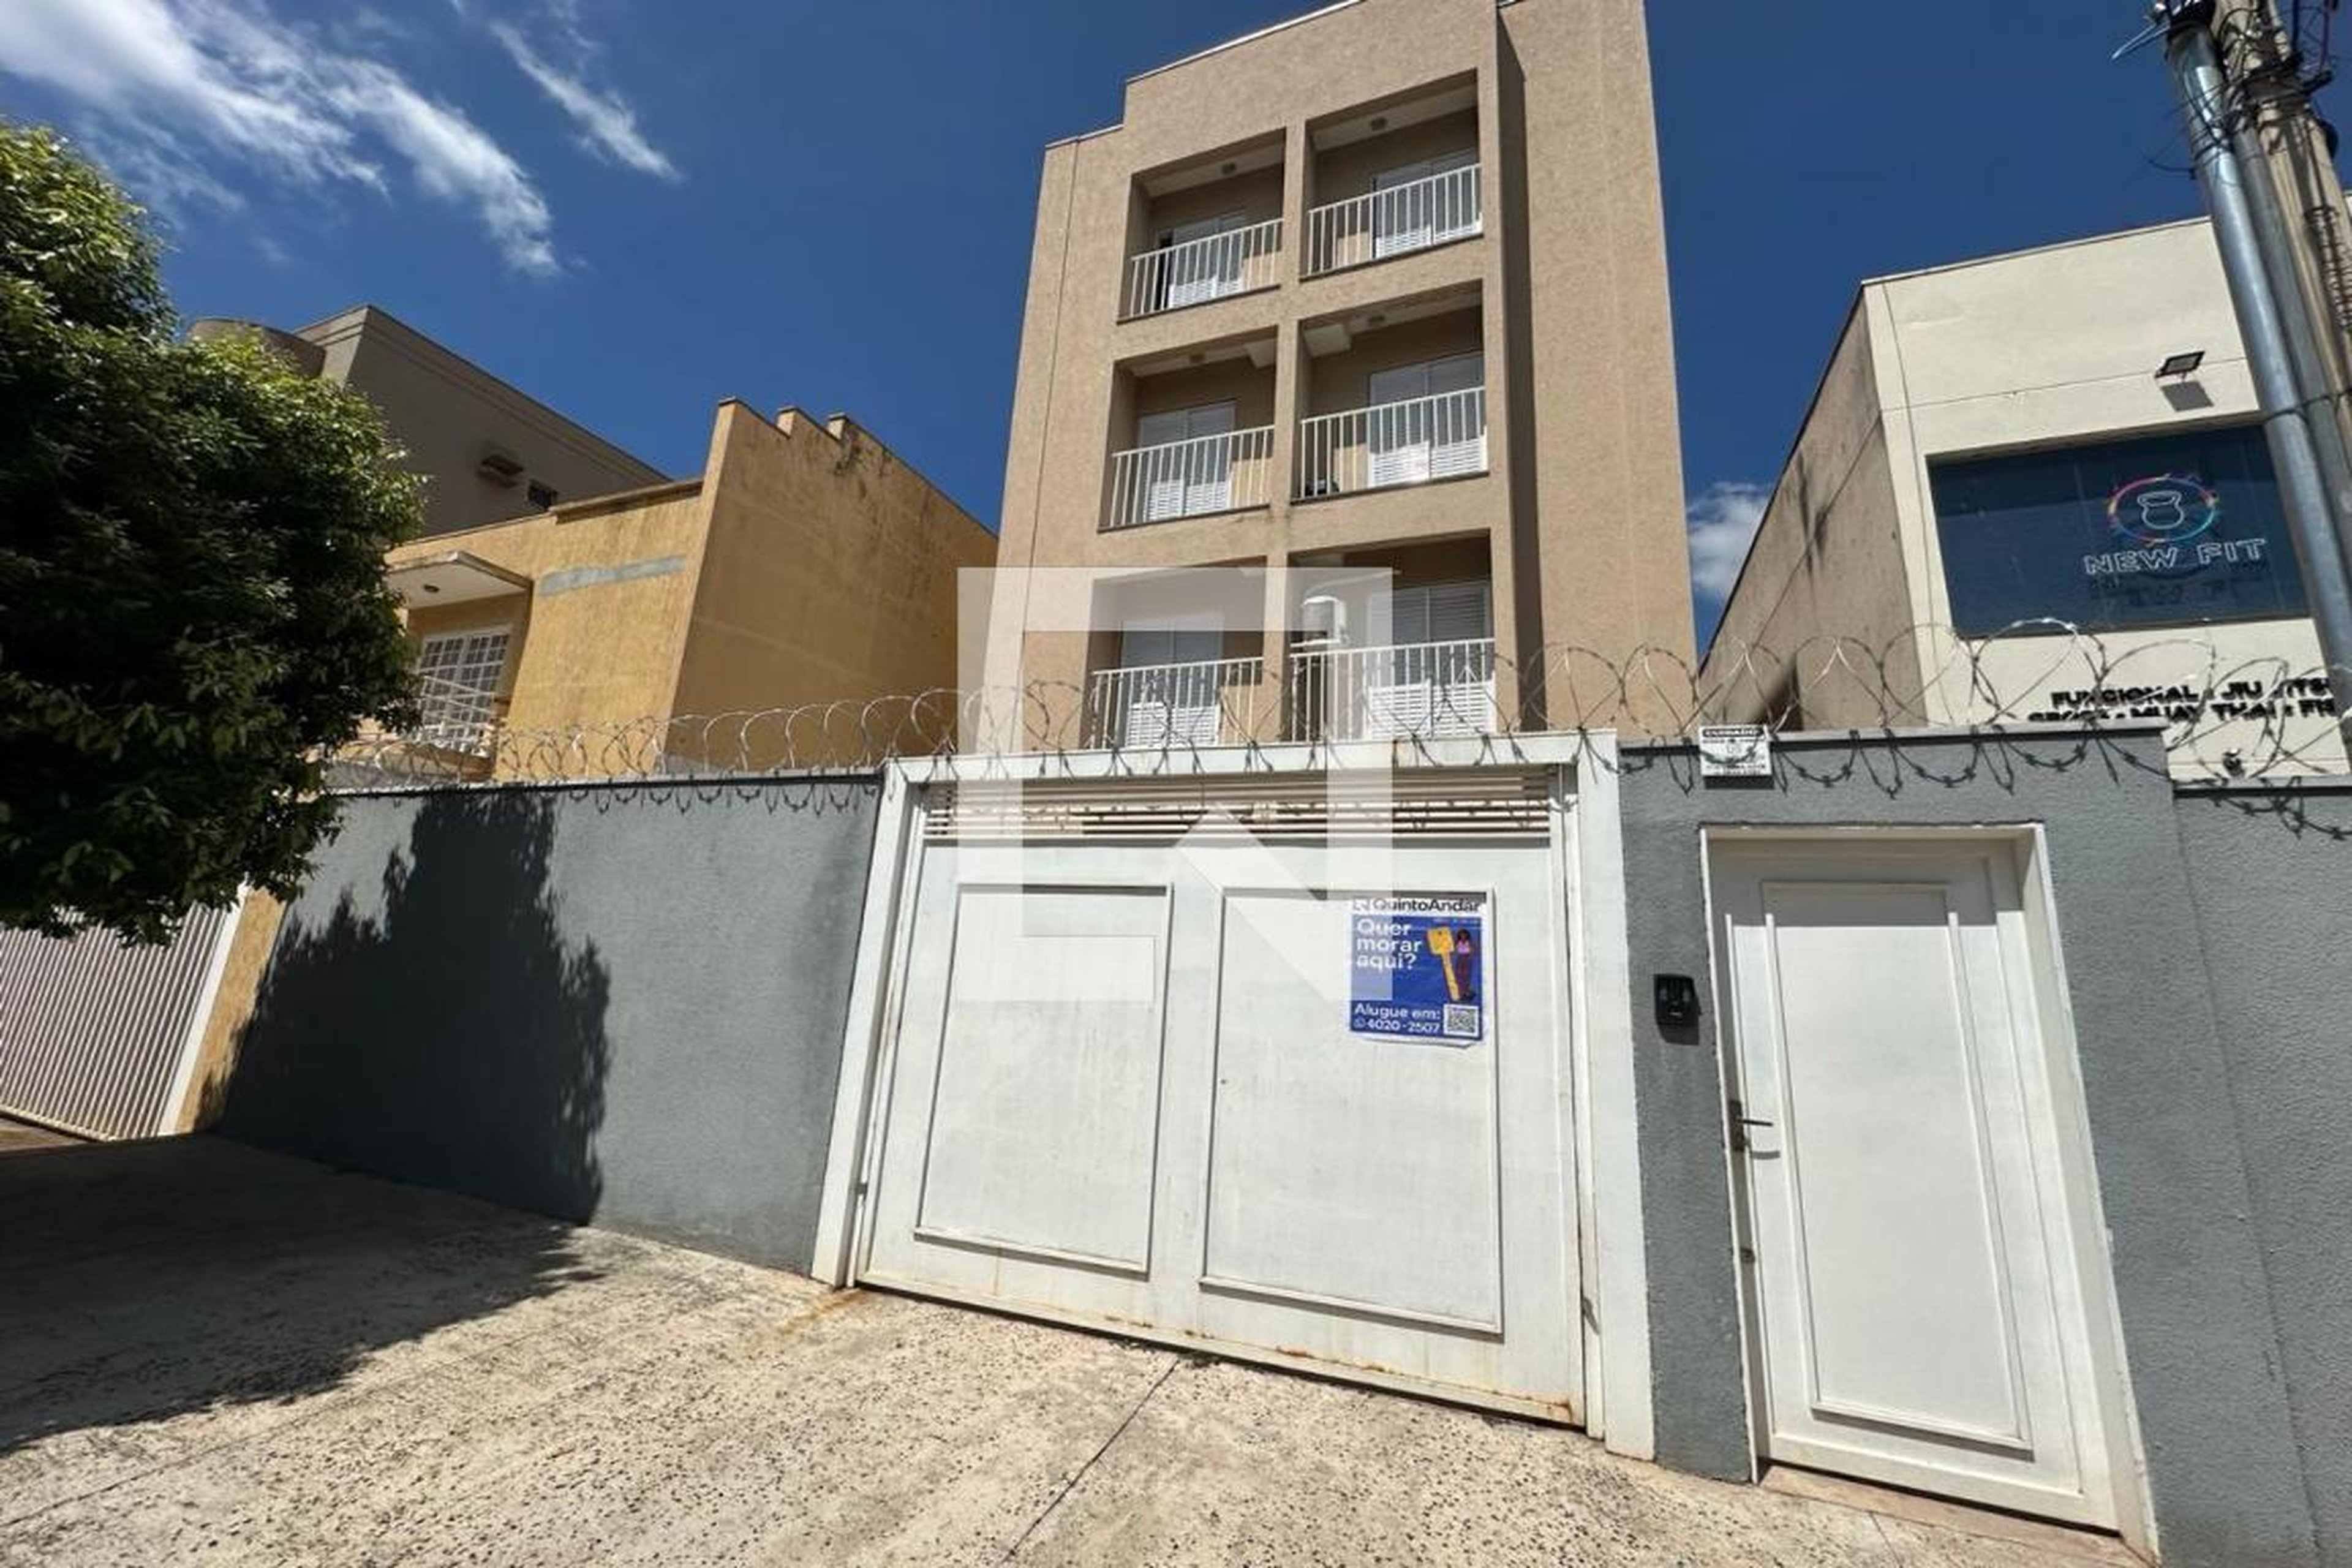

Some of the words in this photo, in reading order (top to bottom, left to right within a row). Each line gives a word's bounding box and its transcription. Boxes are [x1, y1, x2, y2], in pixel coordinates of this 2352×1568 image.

[2083, 548, 2178, 575] NEW
[2196, 538, 2265, 565] FIT
[1373, 897, 1480, 912] QuintoAndar
[1357, 918, 1411, 936] Quer
[1357, 938, 1422, 952] morar
[1357, 953, 1417, 973] aqui?
[1355, 1003, 1408, 1019] Alugue
[1412, 1010, 1440, 1020] em:
